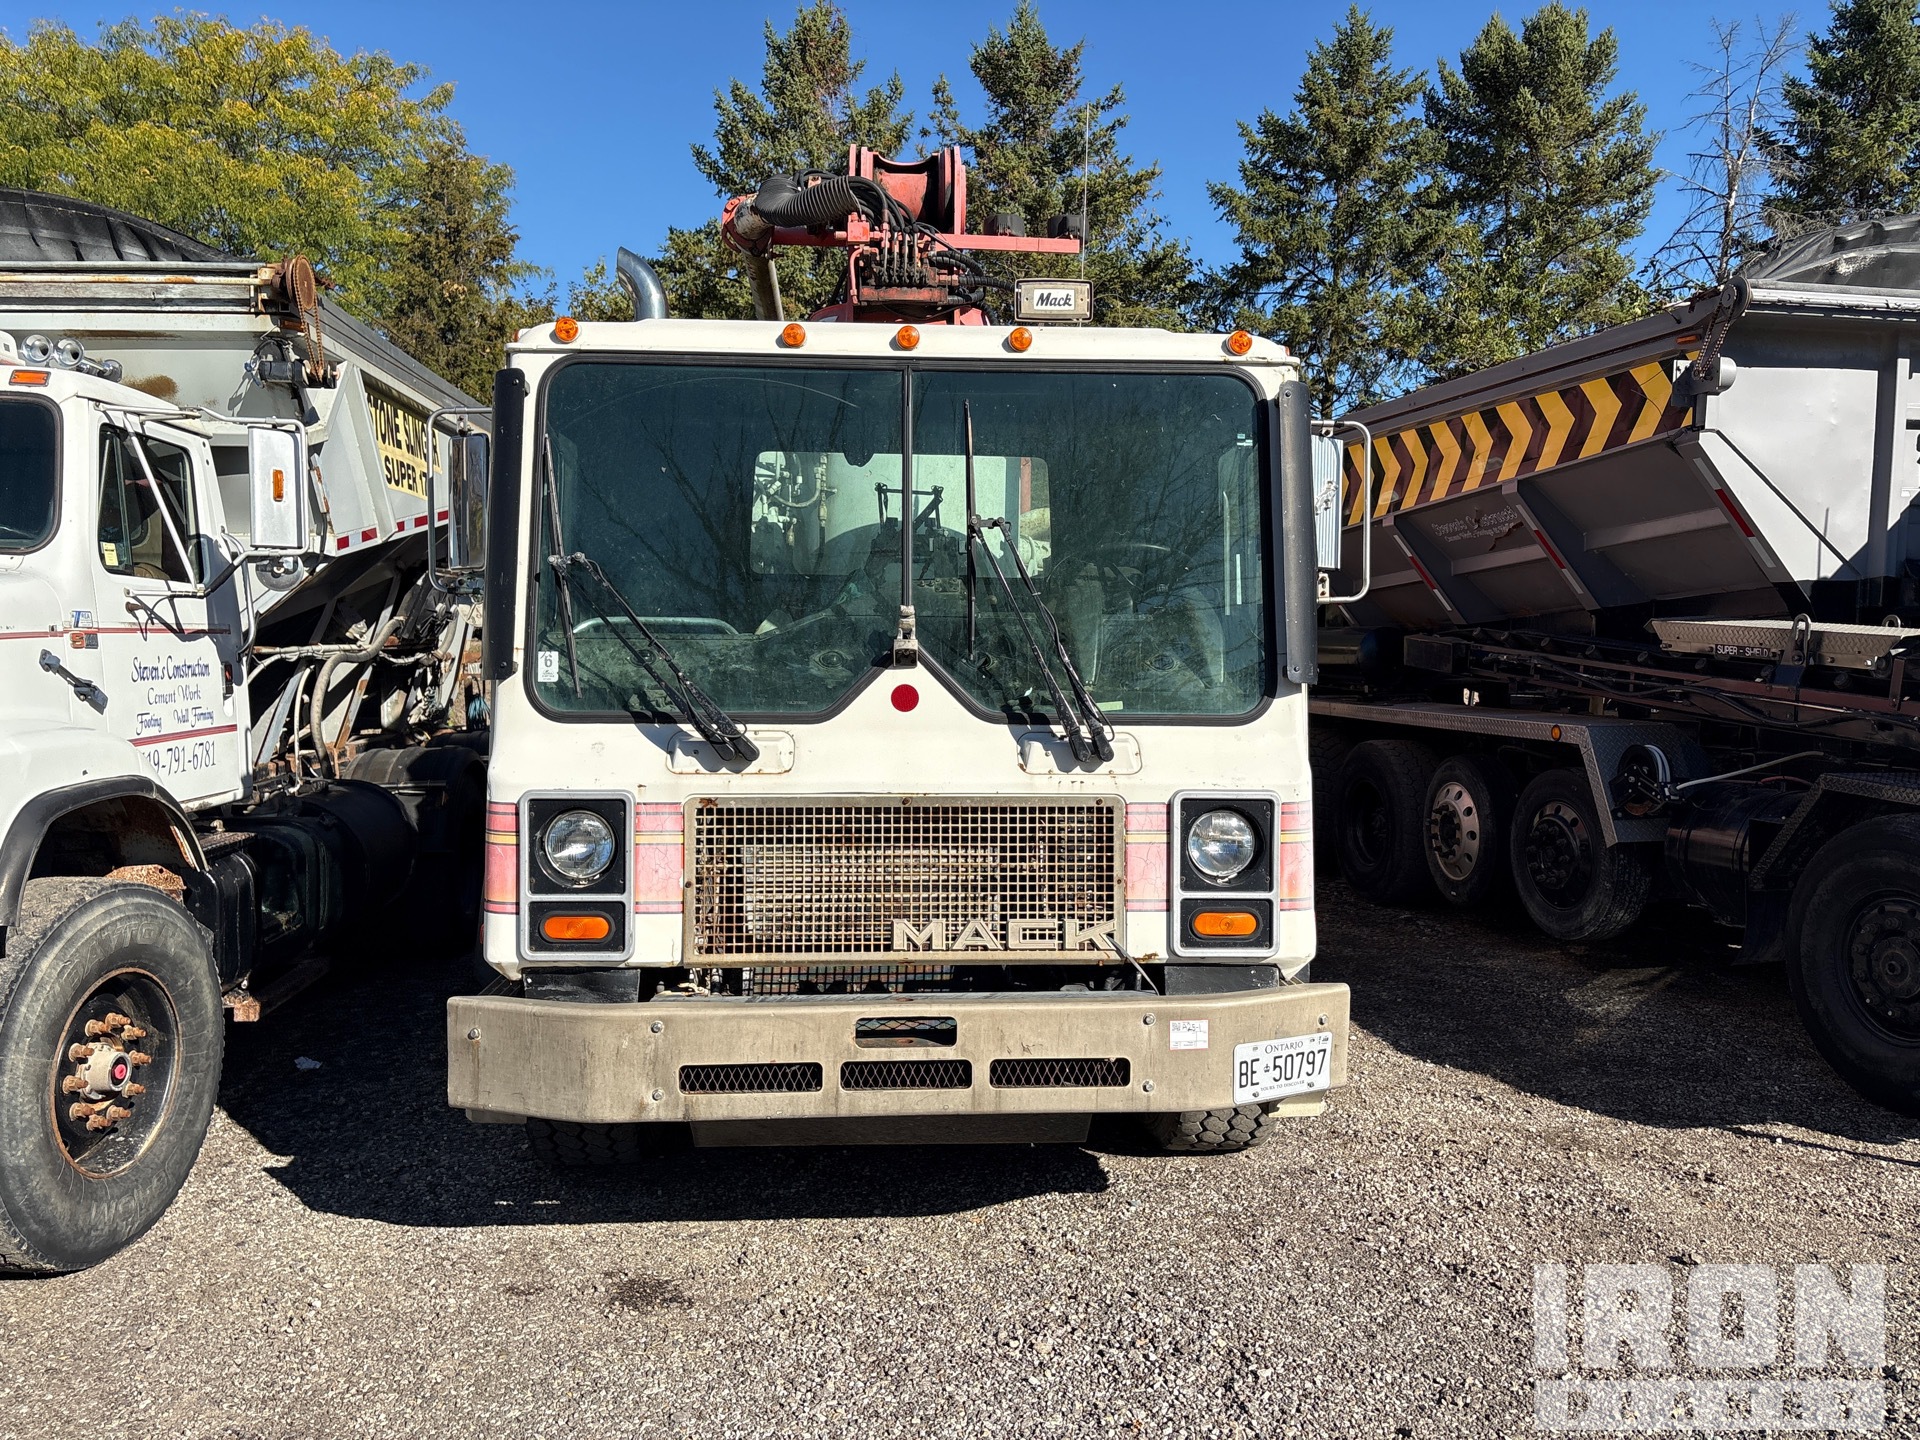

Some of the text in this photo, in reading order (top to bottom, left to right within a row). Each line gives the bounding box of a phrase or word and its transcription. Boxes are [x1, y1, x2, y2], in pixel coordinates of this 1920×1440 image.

[1036, 292, 1072, 306] Mack
[403, 411, 440, 468] SLINGR
[384, 455, 418, 493] SUPER
[1717, 645, 1738, 655] SUPER
[131, 655, 210, 682] Steven's Construction
[147, 684, 201, 705] Cement Work
[173, 708, 189, 724] Wall
[190, 706, 214, 728] Forming
[142, 741, 216, 776] 19-791-6781
[892, 918, 1117, 951] MACK
[1264, 1041, 1304, 1054] ONTARIO
[1239, 1048, 1327, 1088] BE 50797
